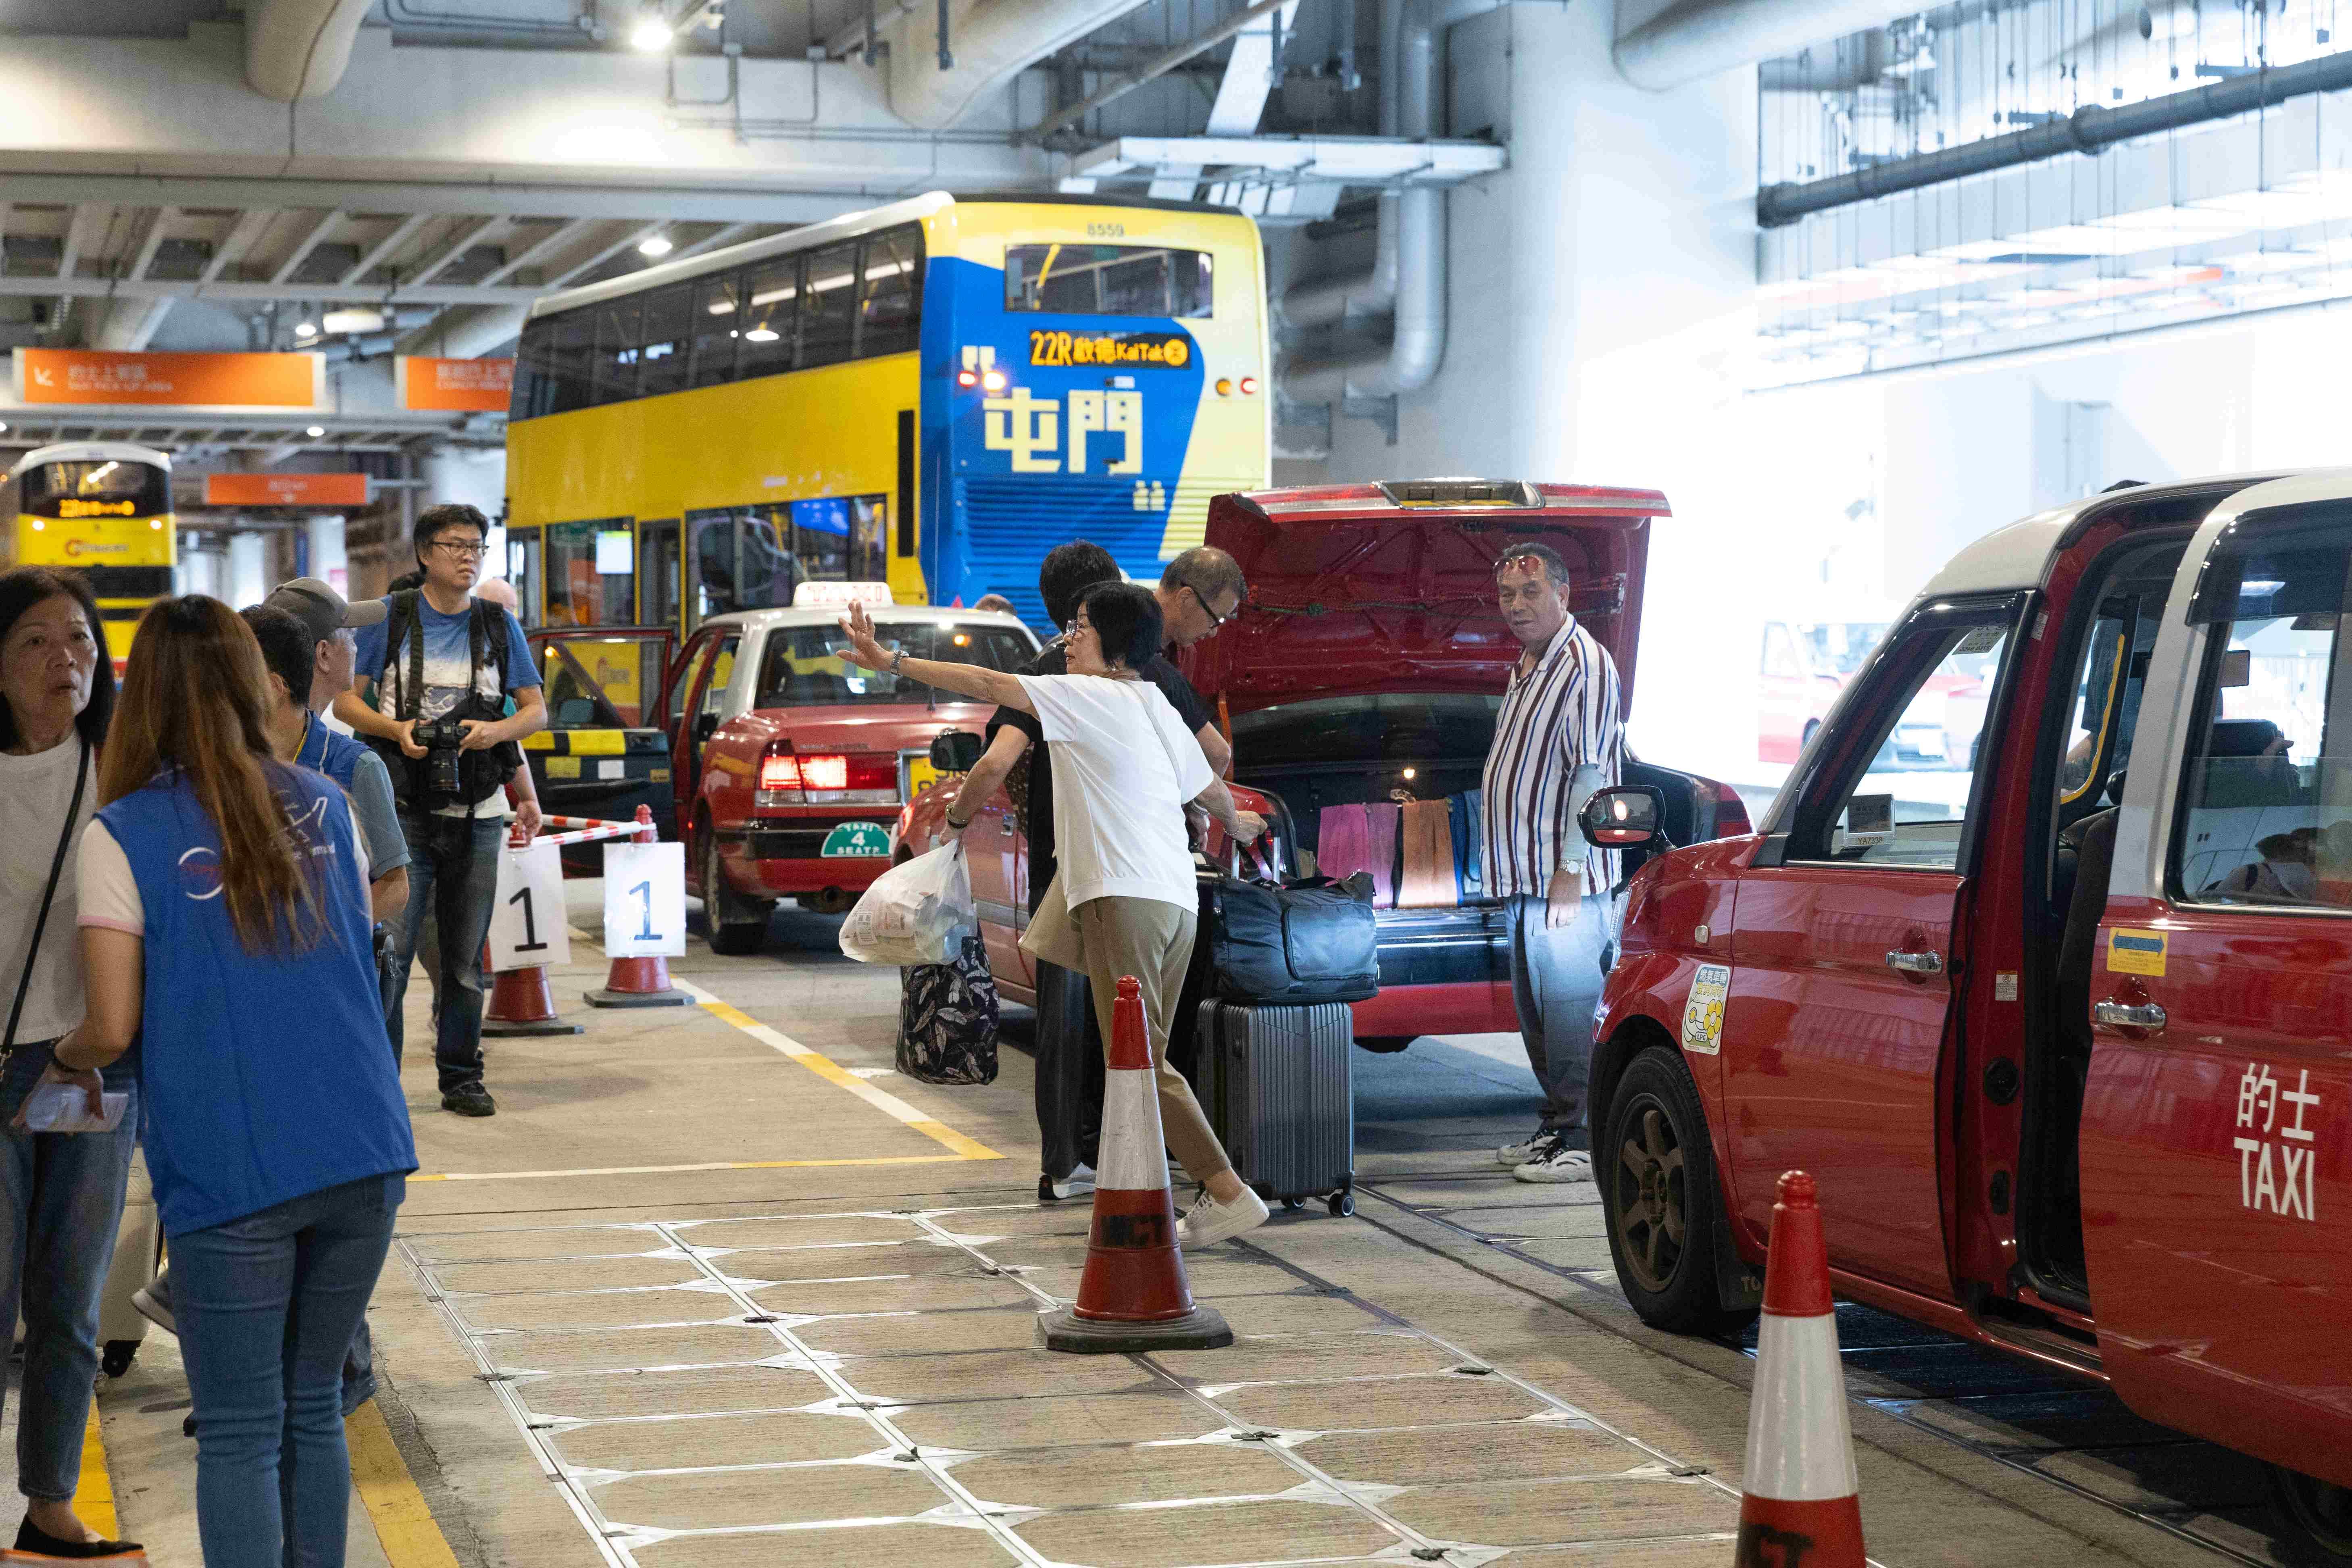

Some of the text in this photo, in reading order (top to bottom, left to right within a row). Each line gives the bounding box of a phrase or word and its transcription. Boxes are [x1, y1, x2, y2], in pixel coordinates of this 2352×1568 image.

[1030, 331, 1073, 366] 22R
[983, 387, 1142, 475] 屯門
[807, 586, 882, 602] TAXI
[844, 823, 875, 832] TAXI
[851, 832, 865, 846] 4
[509, 887, 548, 952] 1
[629, 881, 662, 940] 1
[2237, 1063, 2320, 1142] 的士
[2234, 1137, 2315, 1222] TAXI
